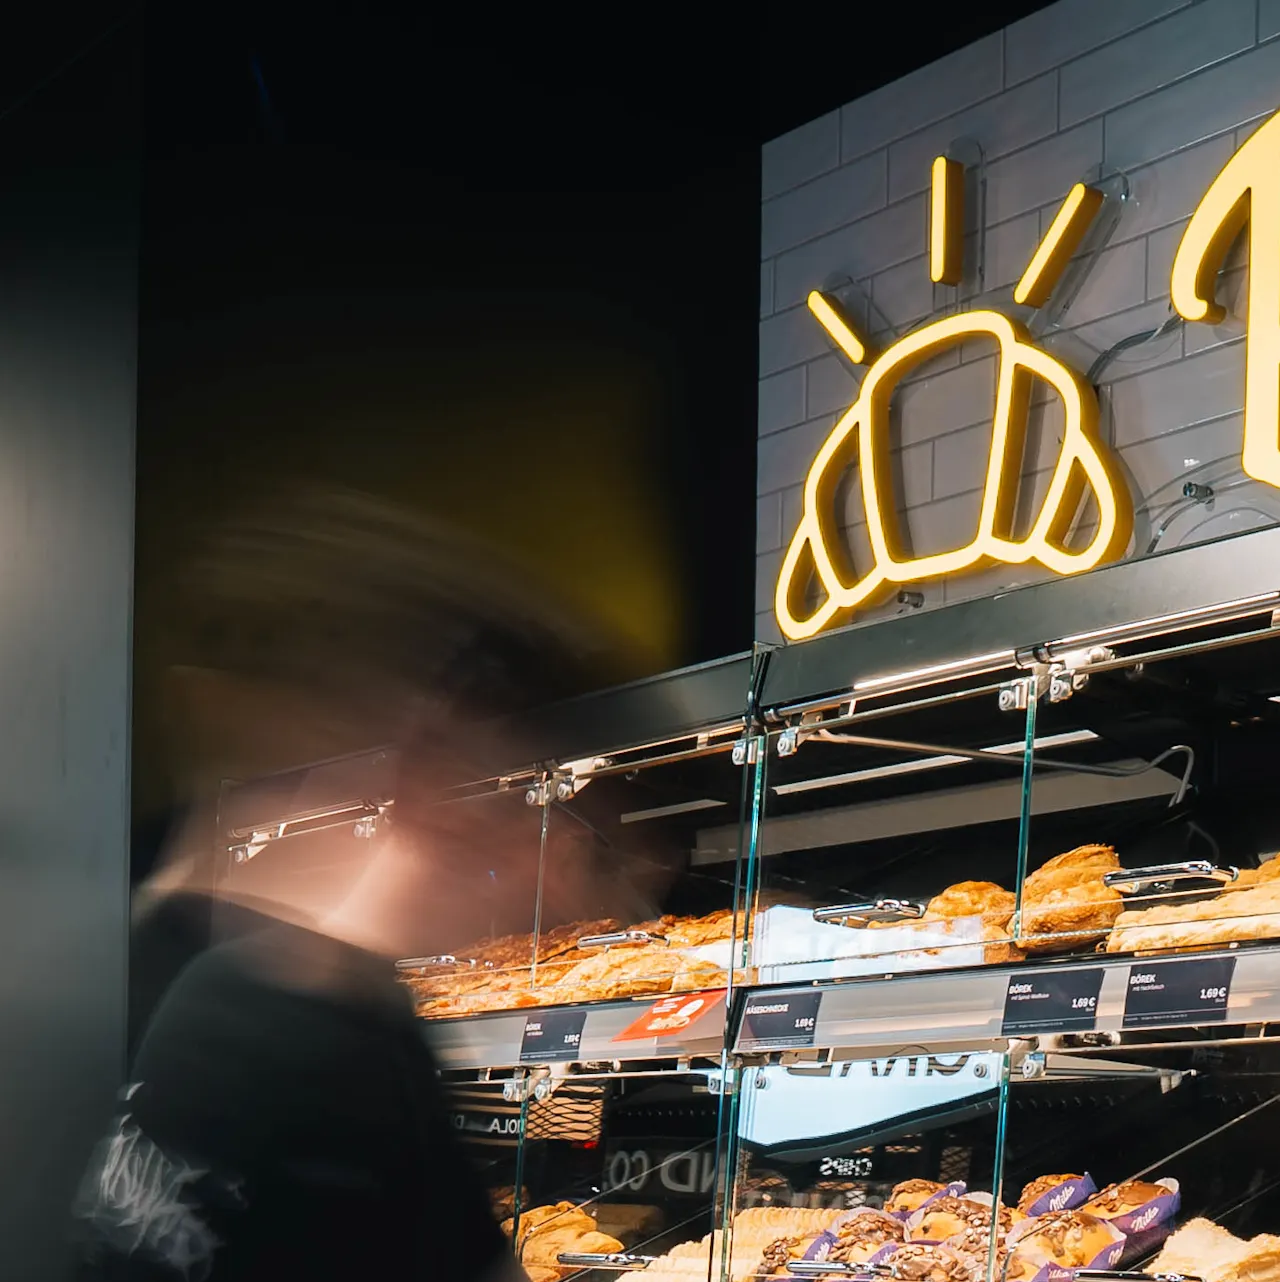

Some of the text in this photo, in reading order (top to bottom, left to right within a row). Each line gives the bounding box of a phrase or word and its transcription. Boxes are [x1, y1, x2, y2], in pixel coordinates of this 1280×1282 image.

[1130, 973, 1156, 985] BÖREK
[1219, 987, 1227, 997] €
[1088, 997, 1096, 1007] €
[1049, 1185, 1075, 1211] Milka
